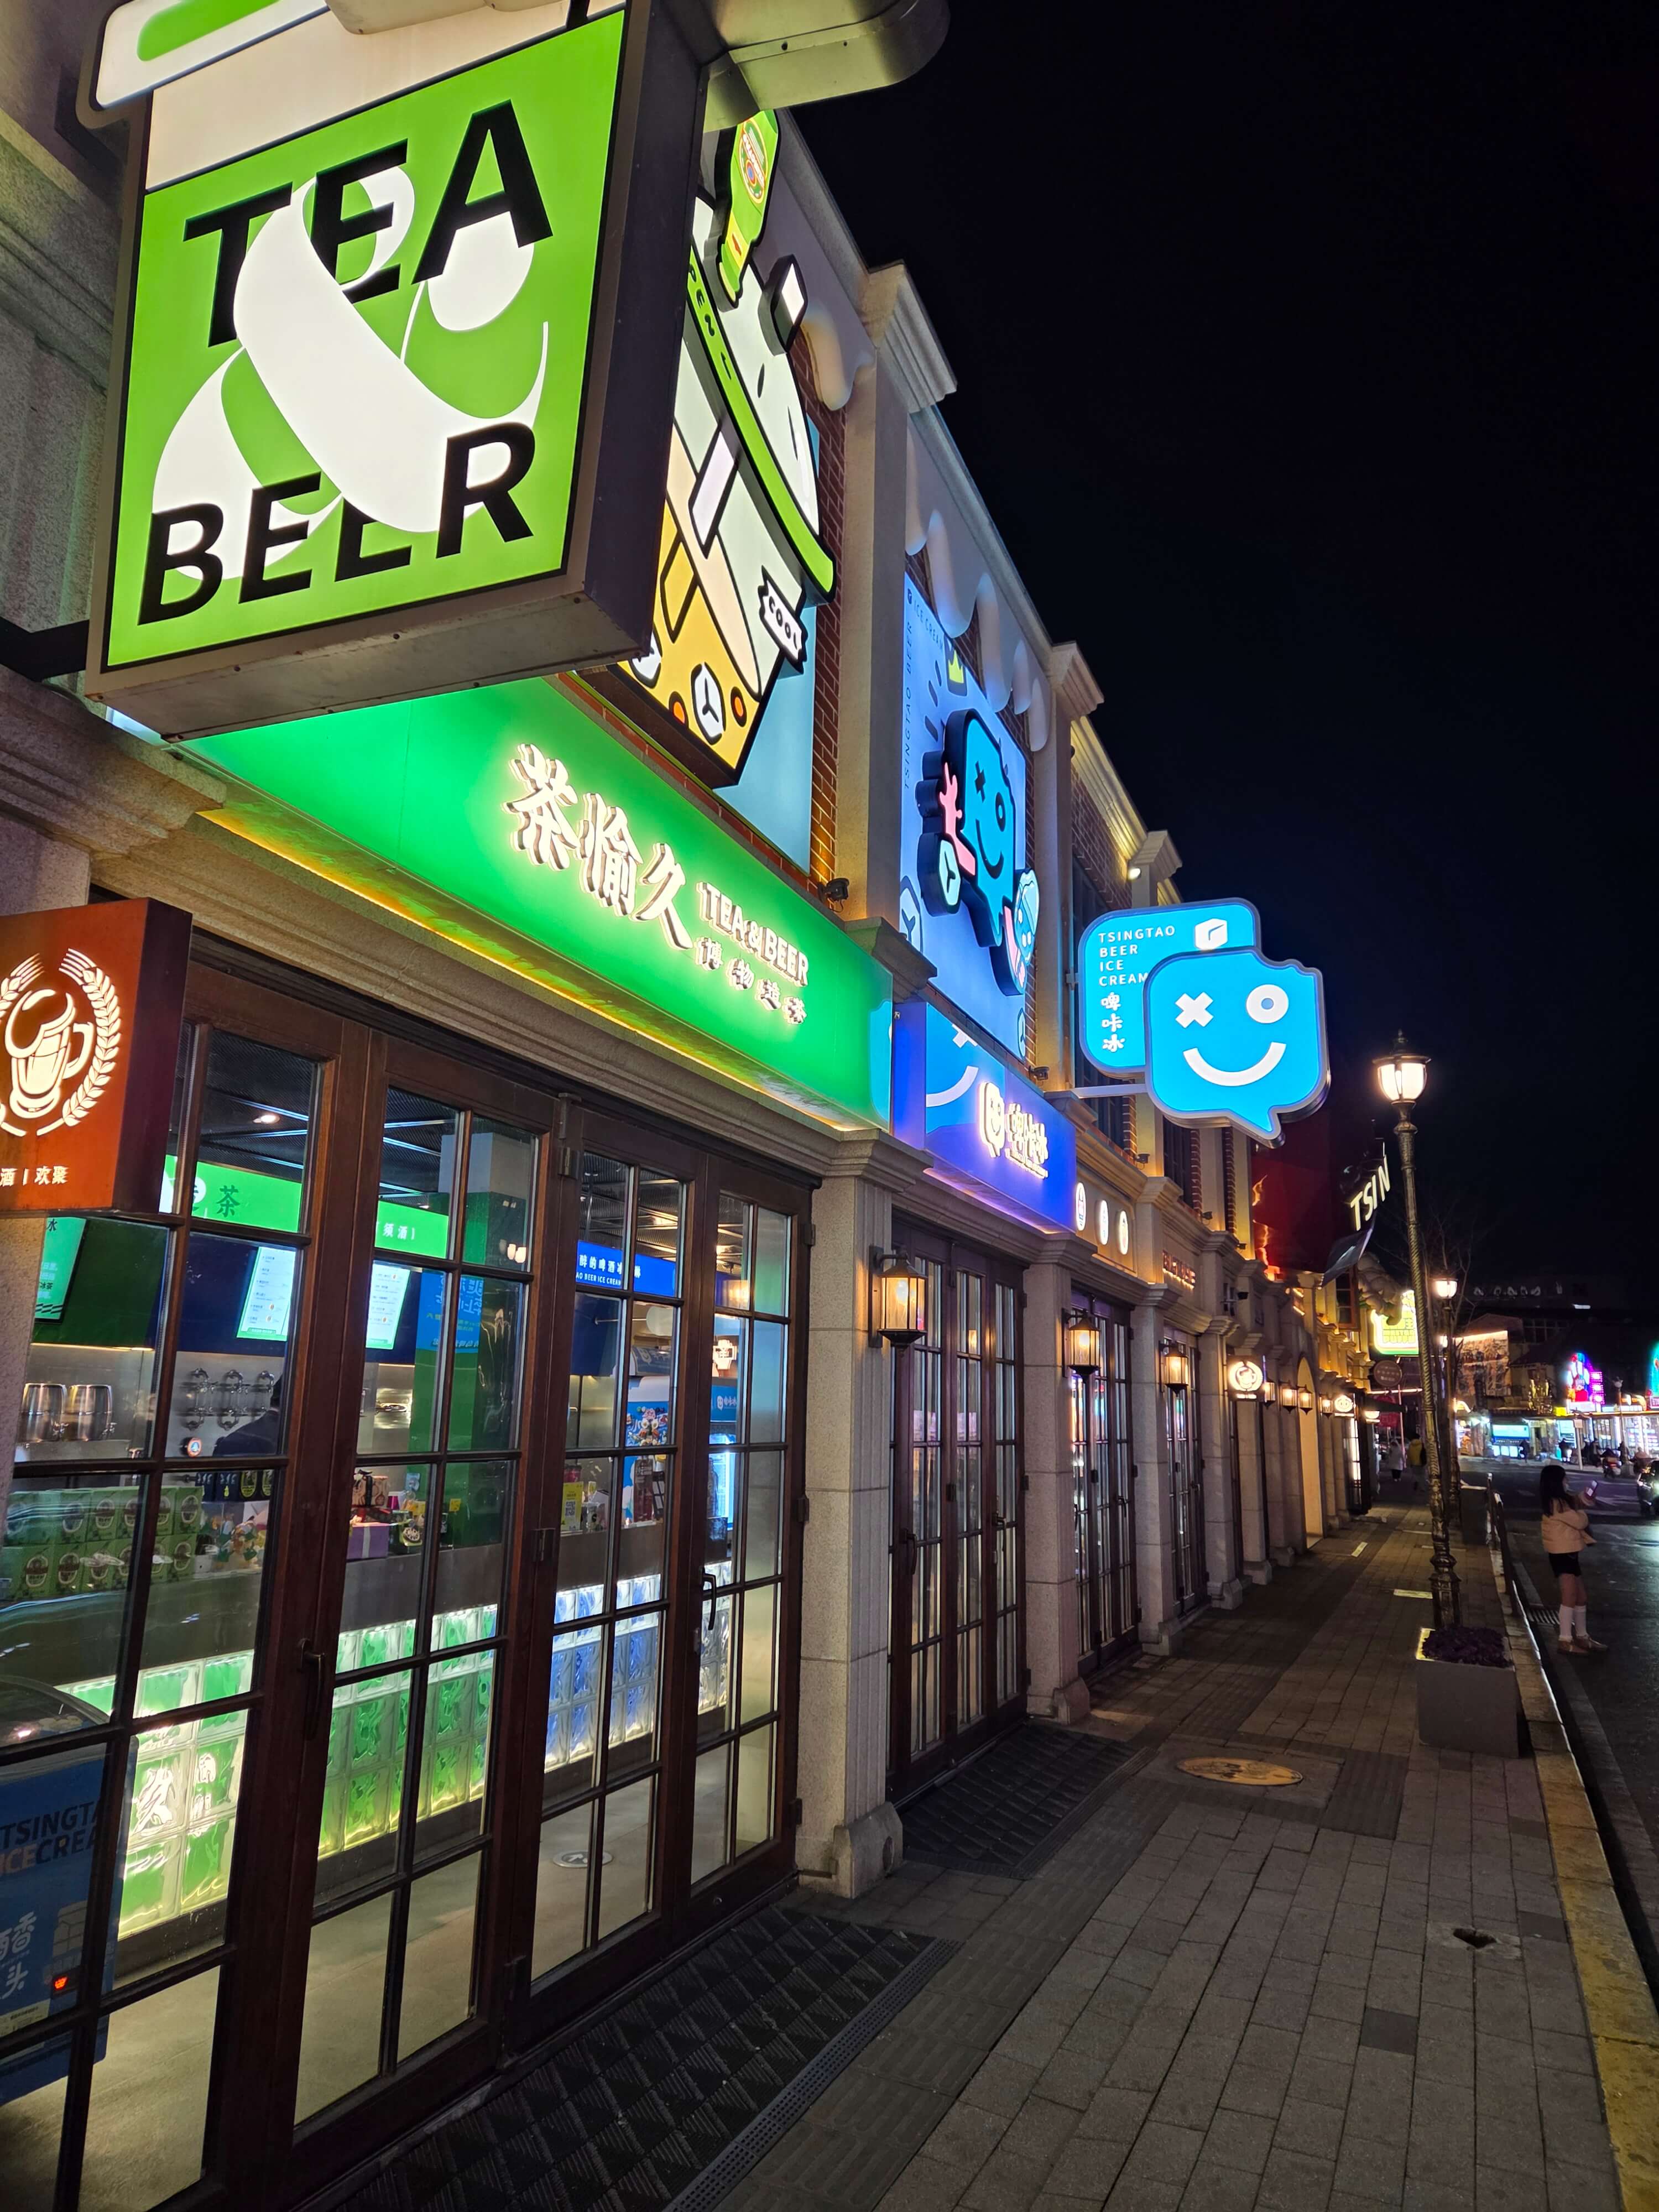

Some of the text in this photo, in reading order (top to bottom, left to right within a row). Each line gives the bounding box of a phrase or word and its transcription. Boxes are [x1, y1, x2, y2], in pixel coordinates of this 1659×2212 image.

[183, 98, 554, 347] TEA
[137, 421, 535, 625] BEER
[1099, 925, 1176, 943] TSINGTAO
[1099, 944, 1138, 958] BEER
[1100, 959, 1124, 972] ICE
[1099, 972, 1149, 987] CREAM
[1100, 992, 1125, 1052] 啤咔冰
[216, 1185, 241, 1218] 茶
[584, 1273, 597, 1282] BEER
[597, 1275, 606, 1284] ICE
